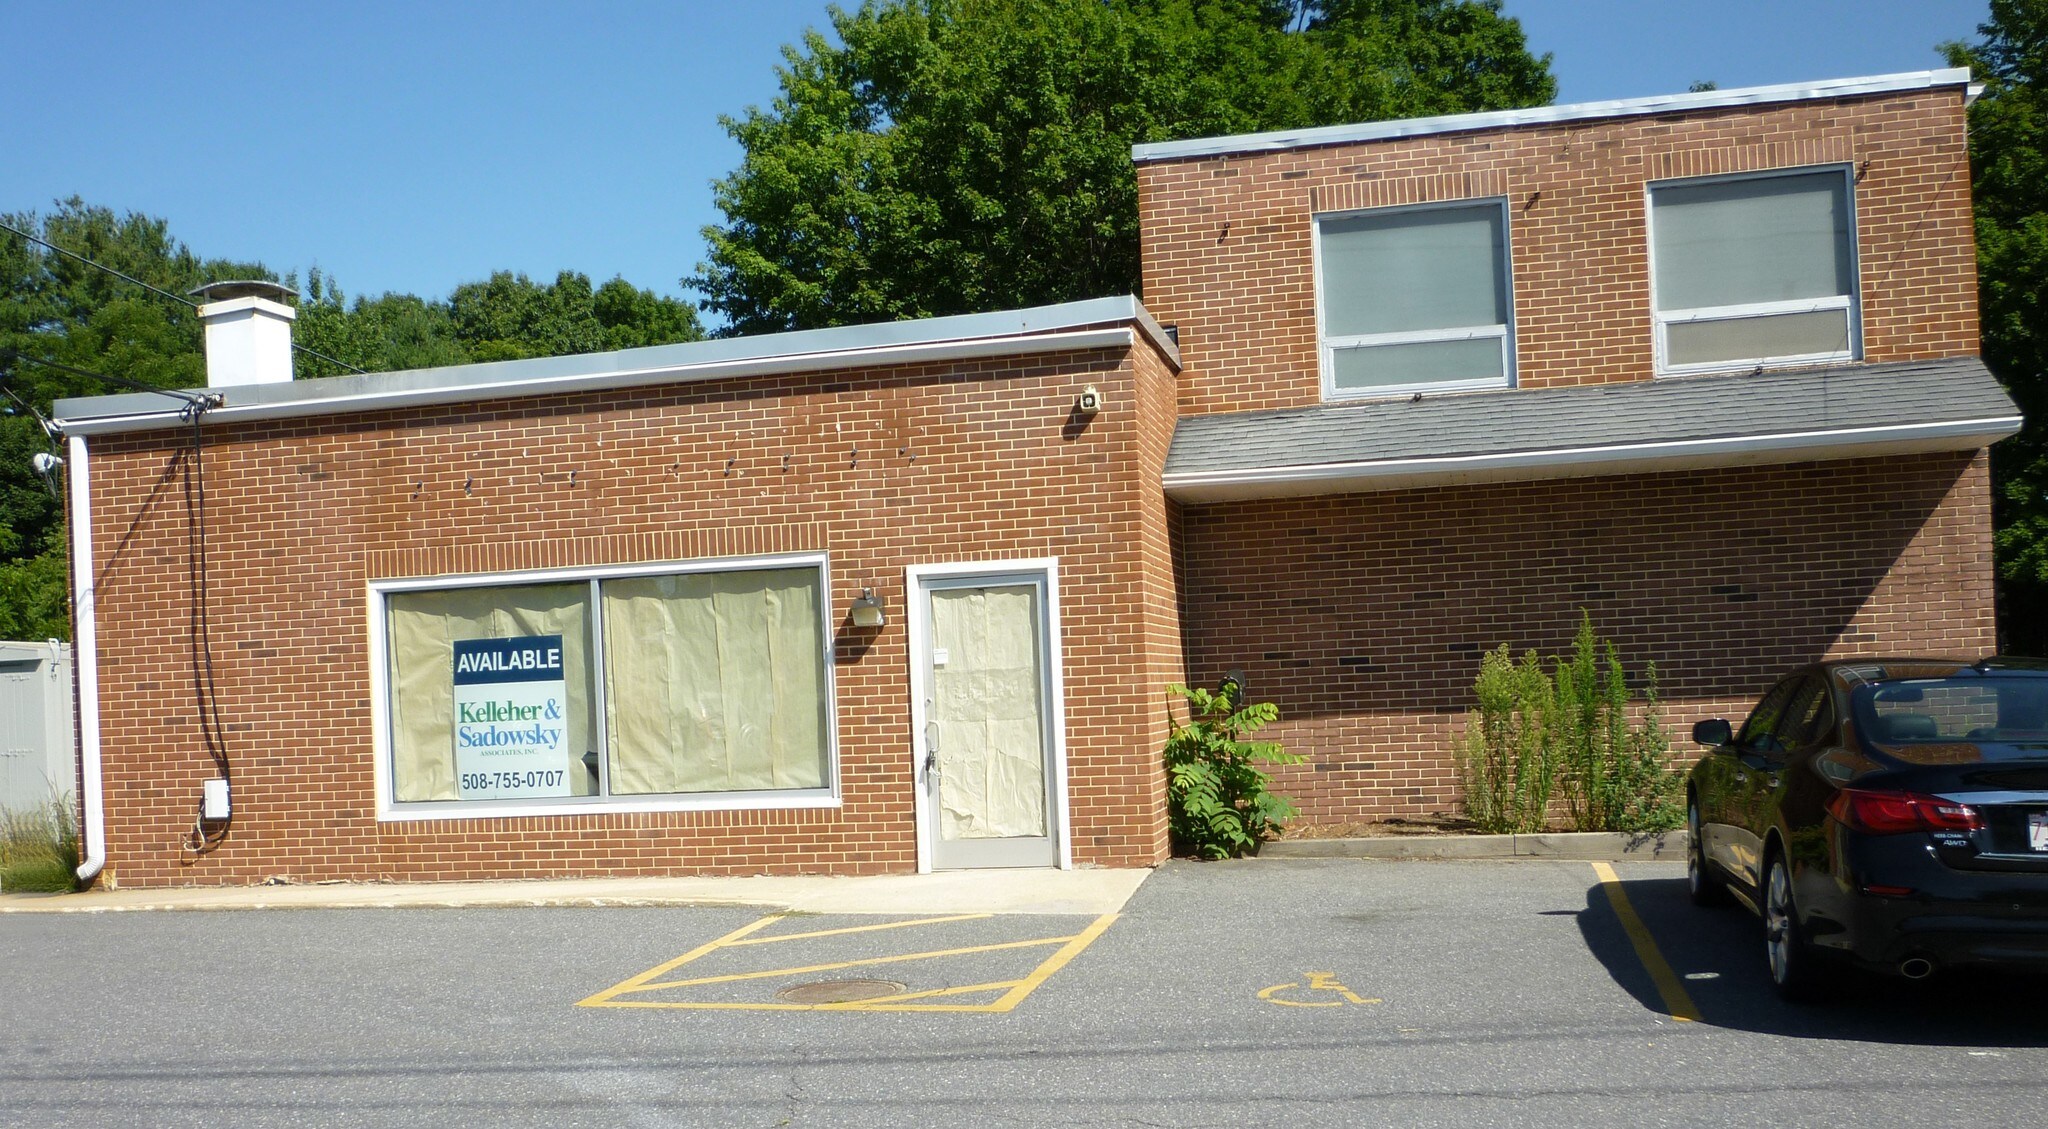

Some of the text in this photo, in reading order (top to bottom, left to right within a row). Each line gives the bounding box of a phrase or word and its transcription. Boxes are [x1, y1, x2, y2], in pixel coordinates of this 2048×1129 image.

[457, 648, 560, 673] AVAILABLE
[459, 698, 561, 723] Kelleher &
[459, 723, 562, 749] Sadowsky
[462, 770, 564, 790] 508-755-0707
